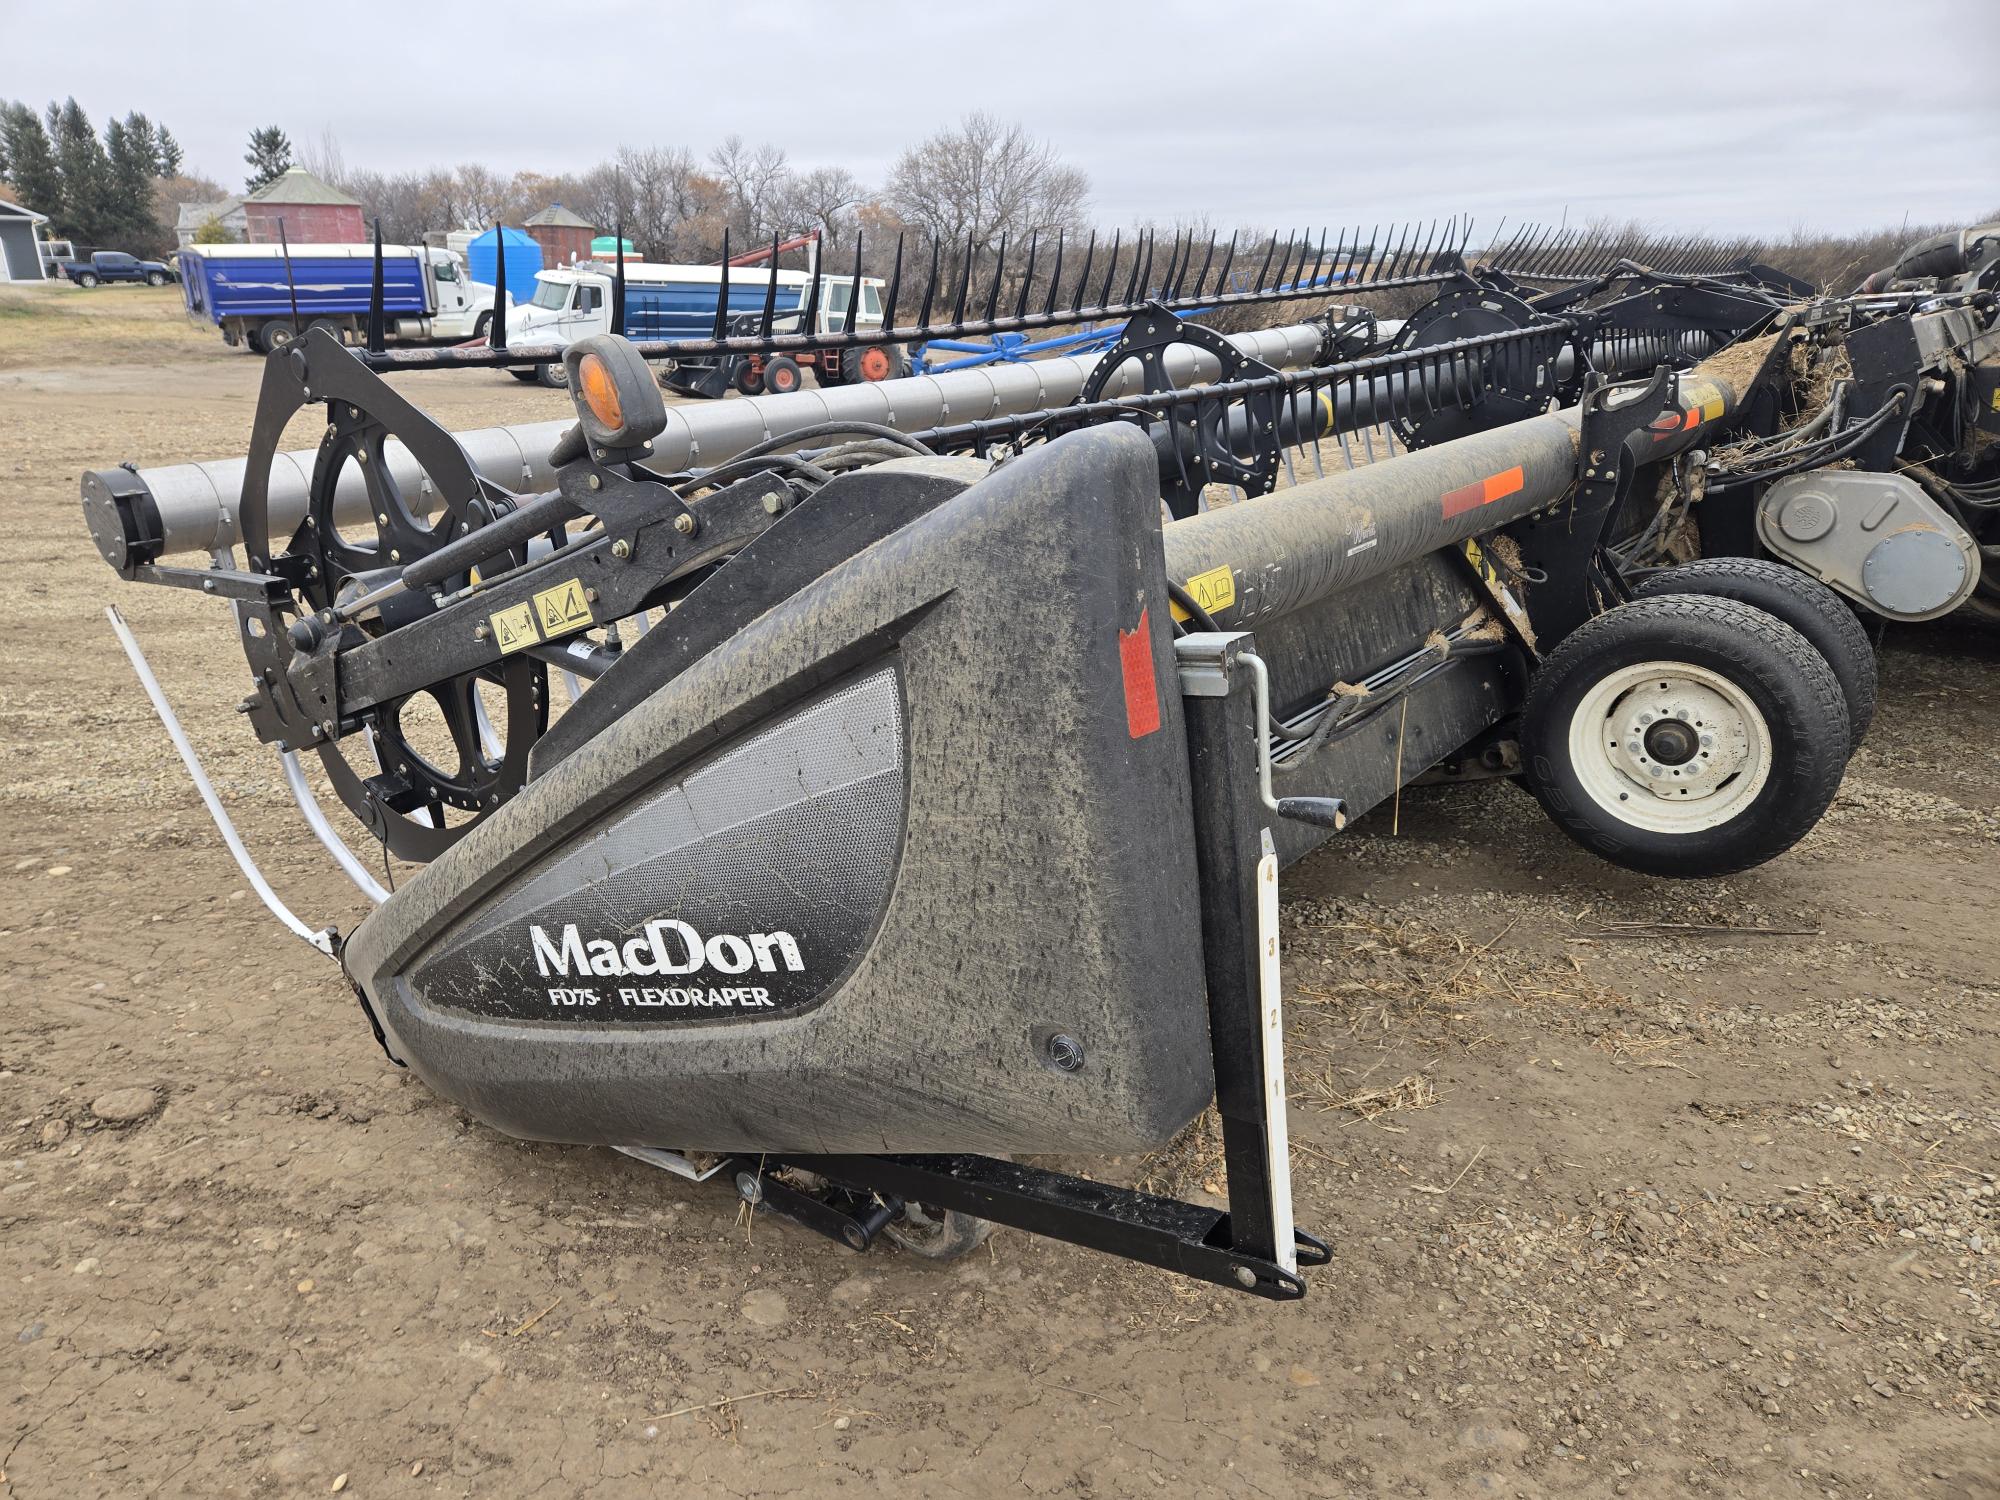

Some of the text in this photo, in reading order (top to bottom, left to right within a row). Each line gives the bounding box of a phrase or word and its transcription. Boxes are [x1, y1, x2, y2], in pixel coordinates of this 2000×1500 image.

[529, 919, 806, 977] MacDon
[1268, 937, 1275, 957] 3
[618, 986, 776, 1007] FLEXDRAPER
[1271, 1008, 1277, 1029] 2
